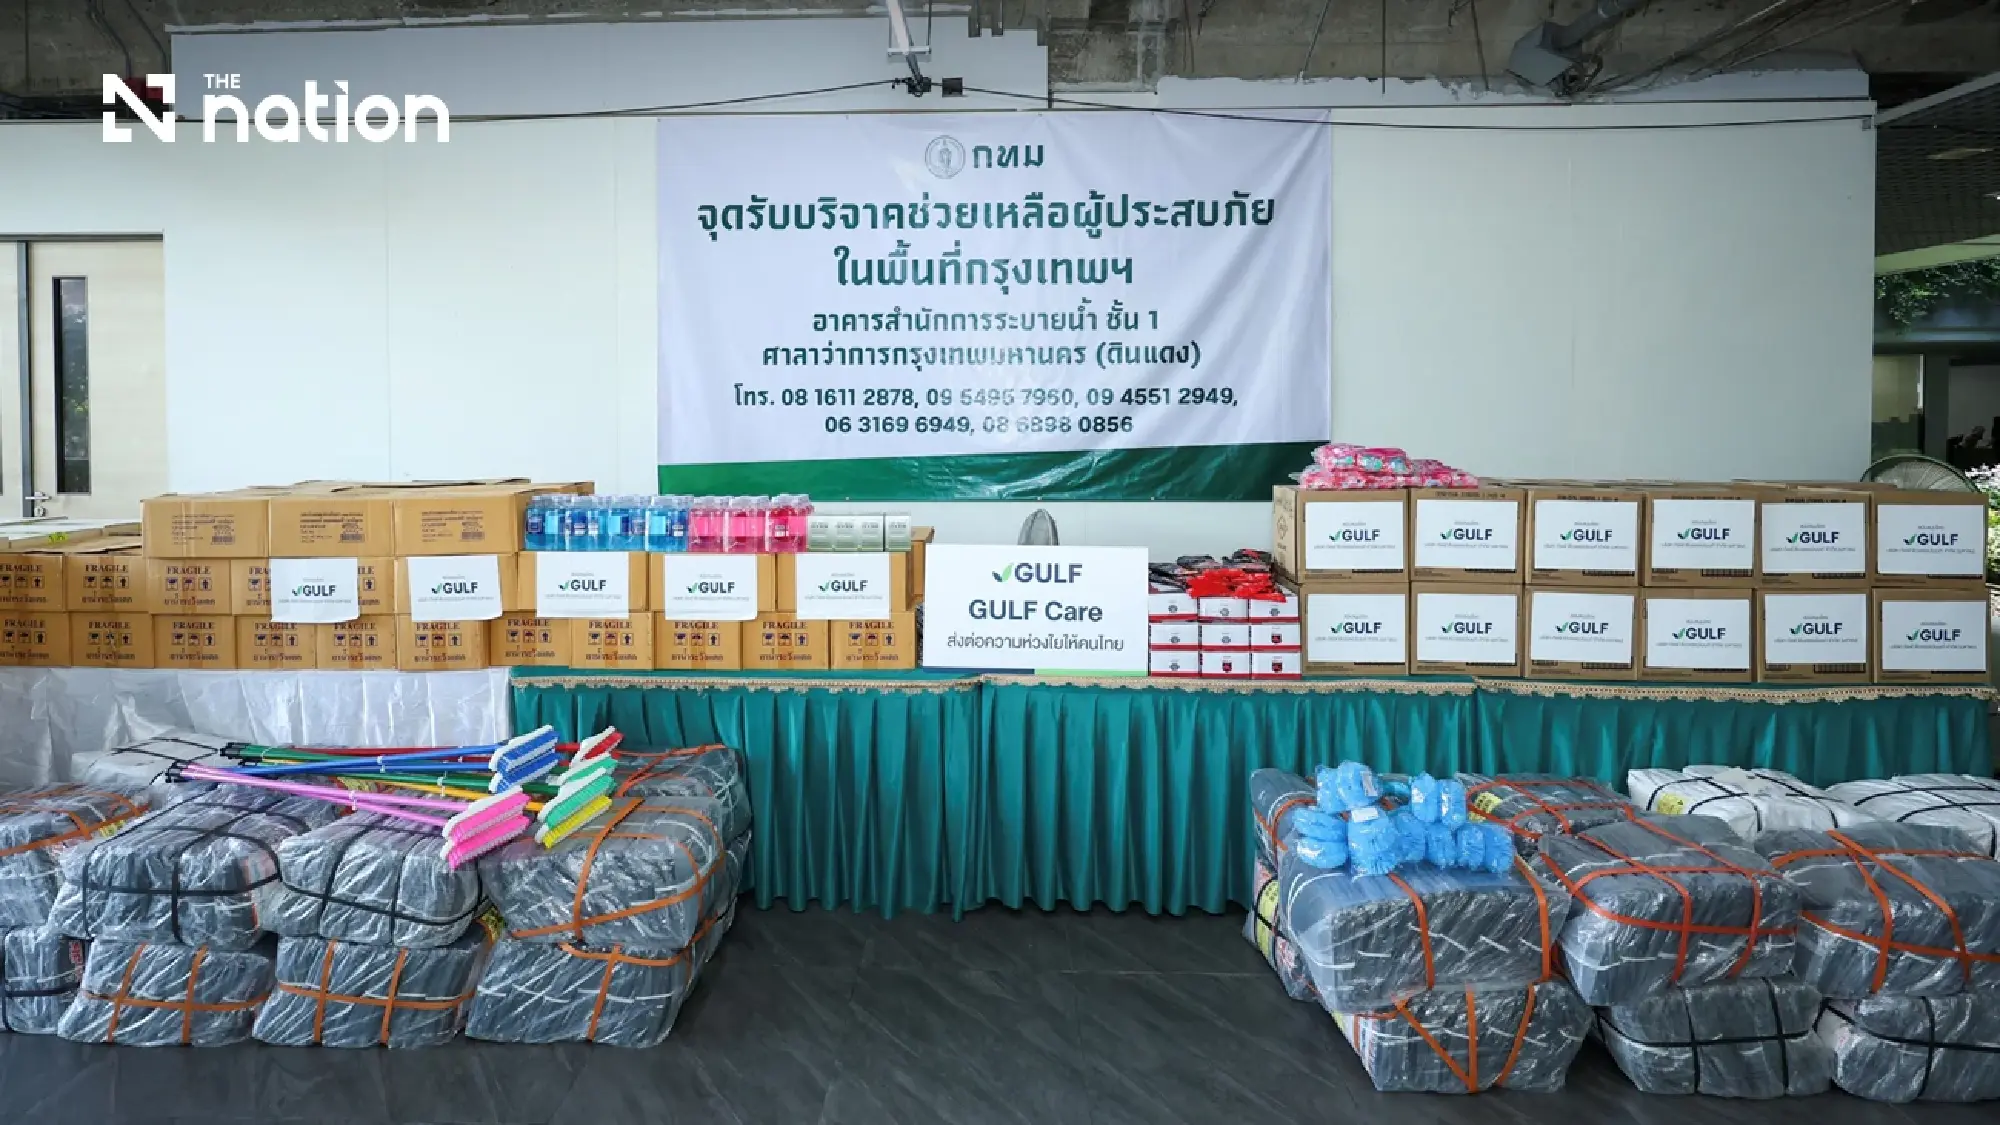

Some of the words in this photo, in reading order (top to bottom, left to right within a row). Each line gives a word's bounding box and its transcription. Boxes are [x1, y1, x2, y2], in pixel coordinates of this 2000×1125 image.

[972, 145, 1044, 169] กทม
[697, 189, 1275, 241] จุดรับบริจาคช่วยเหลือผู้ประสบภัย
[833, 239, 1133, 295] ในพื้นที่กรุงเทพฯ
[813, 298, 1098, 332] อาคารสำนักการระบายน้ำ
[1106, 299, 1139, 332] ชั้น
[1148, 310, 1158, 330] 1
[762, 341, 1087, 373] ศาลาว่าการกรุงเทพมหานคร
[1096, 340, 1202, 370] (ดินแดง)
[734, 383, 775, 406] โทร.
[781, 388, 809, 406] 08
[814, 388, 856, 406] 1611
[863, 388, 919, 409] 2878,
[926, 388, 953, 406] 09
[1086, 388, 1115, 406] 09
[1119, 388, 1171, 406] 4551
[1177, 387, 1238, 407] 2949,
[825, 416, 852, 433] 06
[858, 416, 909, 433] 3169
[915, 416, 975, 436] 6949,
[982, 416, 1010, 433] 08
[1077, 416, 1133, 433] 0856
[1342, 528, 1381, 541] GULF
[1453, 527, 1493, 541] GULF
[1573, 528, 1613, 542] GULF
[1691, 527, 1731, 540] GULF
[1799, 531, 1840, 544] GULF
[1916, 533, 1959, 546] GULF
[1014, 562, 1083, 584] GULF
[302, 584, 336, 597] GULF
[442, 581, 478, 595] GULF
[570, 579, 607, 592] GULF
[699, 581, 735, 594] GULF
[830, 579, 868, 592] GULF
[968, 599, 1038, 621] GULF
[1044, 601, 1103, 622] Care
[1343, 621, 1383, 634] GULF
[1453, 621, 1493, 635] GULF
[1568, 621, 1609, 635] GULF
[1685, 627, 1726, 640] GULF
[1802, 622, 1843, 635] GULF
[1919, 628, 1961, 641] GULF
